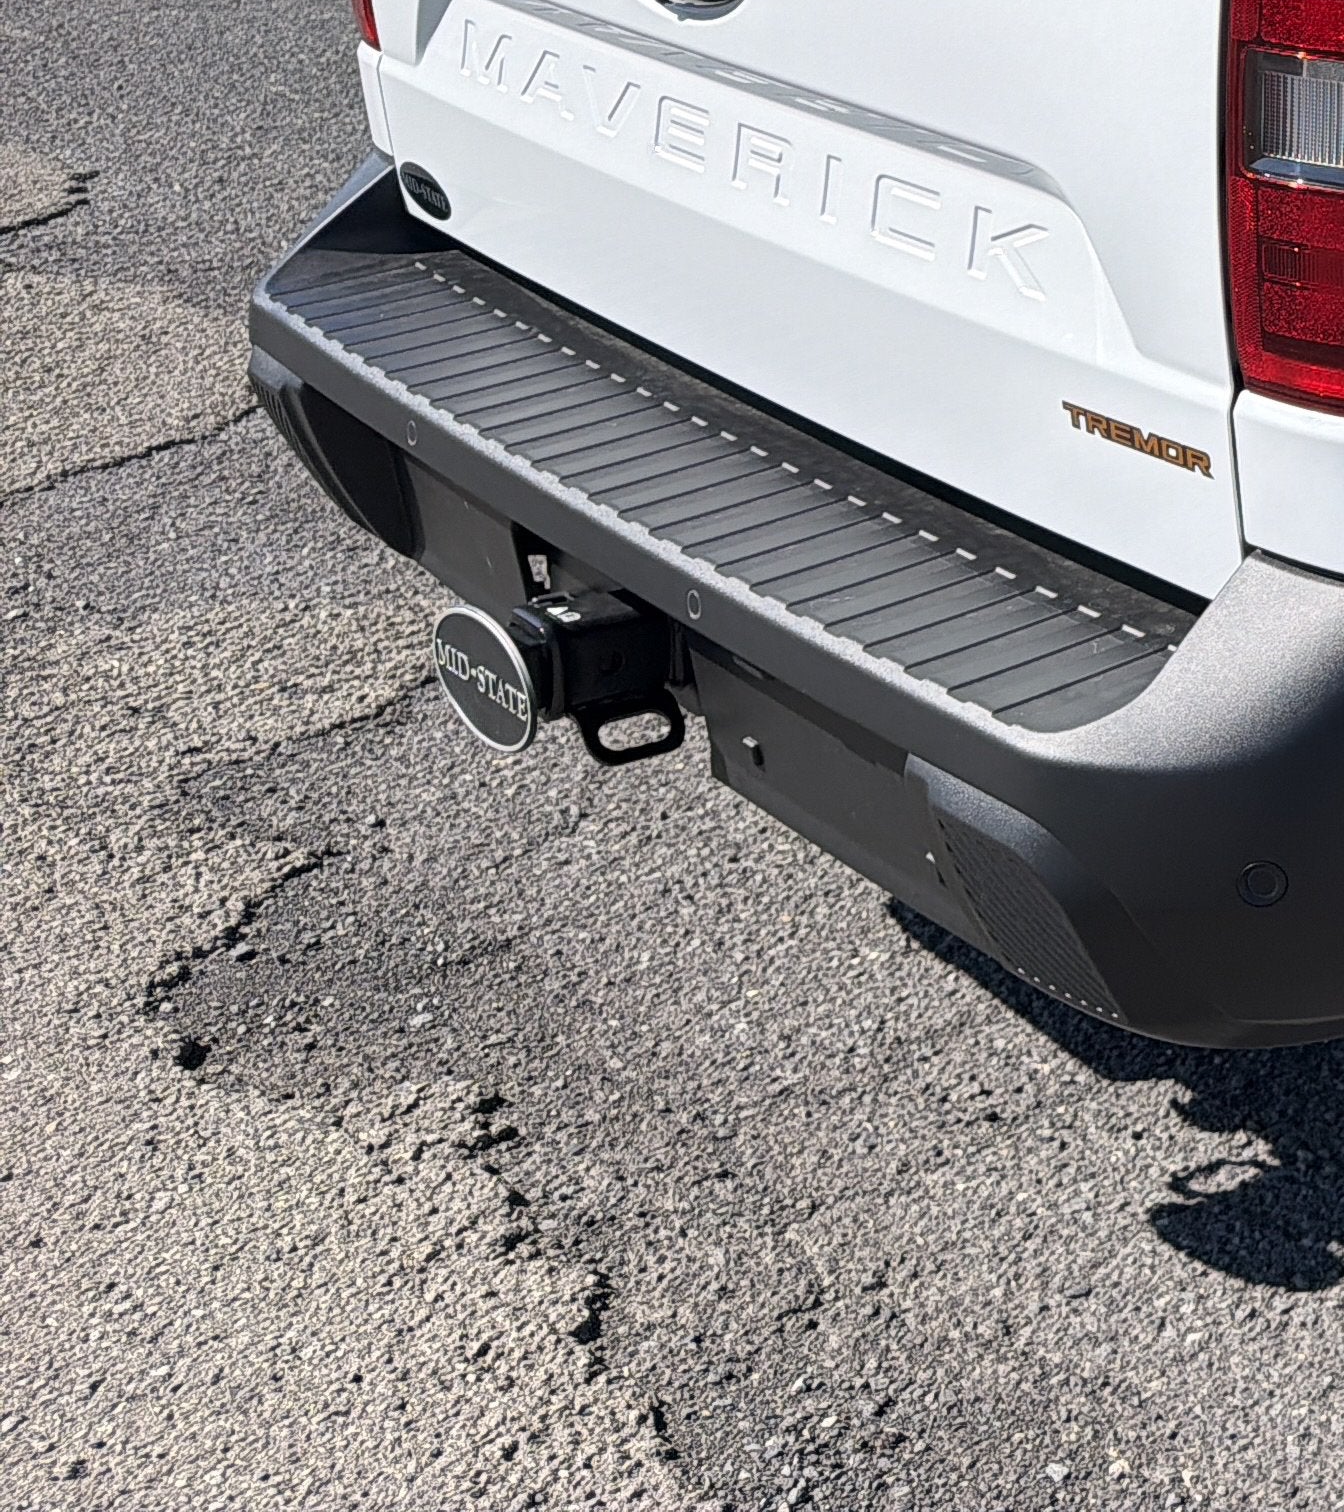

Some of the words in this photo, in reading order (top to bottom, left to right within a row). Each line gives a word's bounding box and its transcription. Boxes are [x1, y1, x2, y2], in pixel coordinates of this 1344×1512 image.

[459, 18, 1051, 303] MAVERICK
[1061, 399, 1215, 480] TREMOR
[436, 638, 528, 723] MID-STATE
